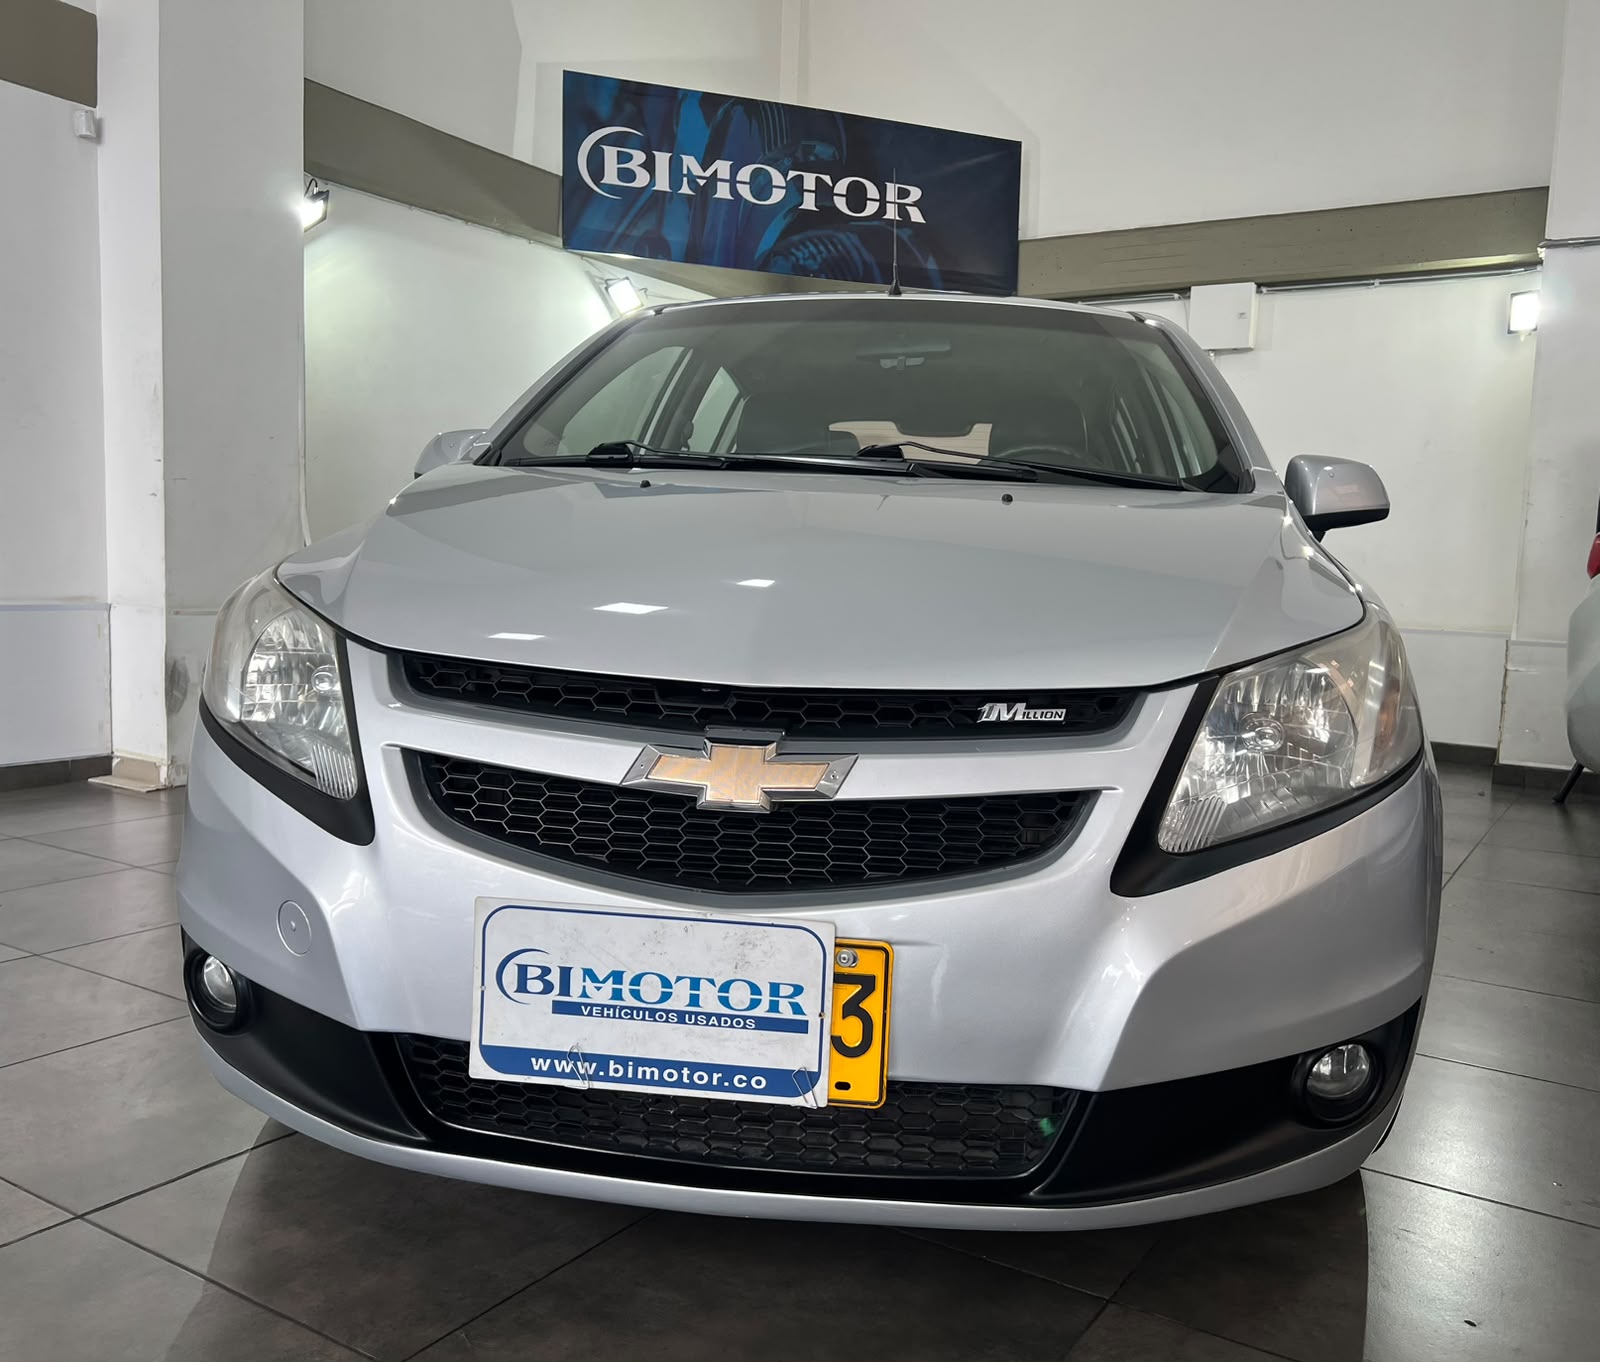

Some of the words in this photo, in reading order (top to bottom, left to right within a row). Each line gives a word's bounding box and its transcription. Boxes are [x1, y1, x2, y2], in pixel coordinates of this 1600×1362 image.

[598, 144, 926, 224] BIMOTOR
[512, 961, 807, 1016] BIMOTOR
[831, 973, 876, 1058] 3
[580, 1004, 679, 1024] VEHÍCULOS
[684, 1013, 756, 1030] USADOS
[530, 1055, 768, 1091] www.bimotor.co
